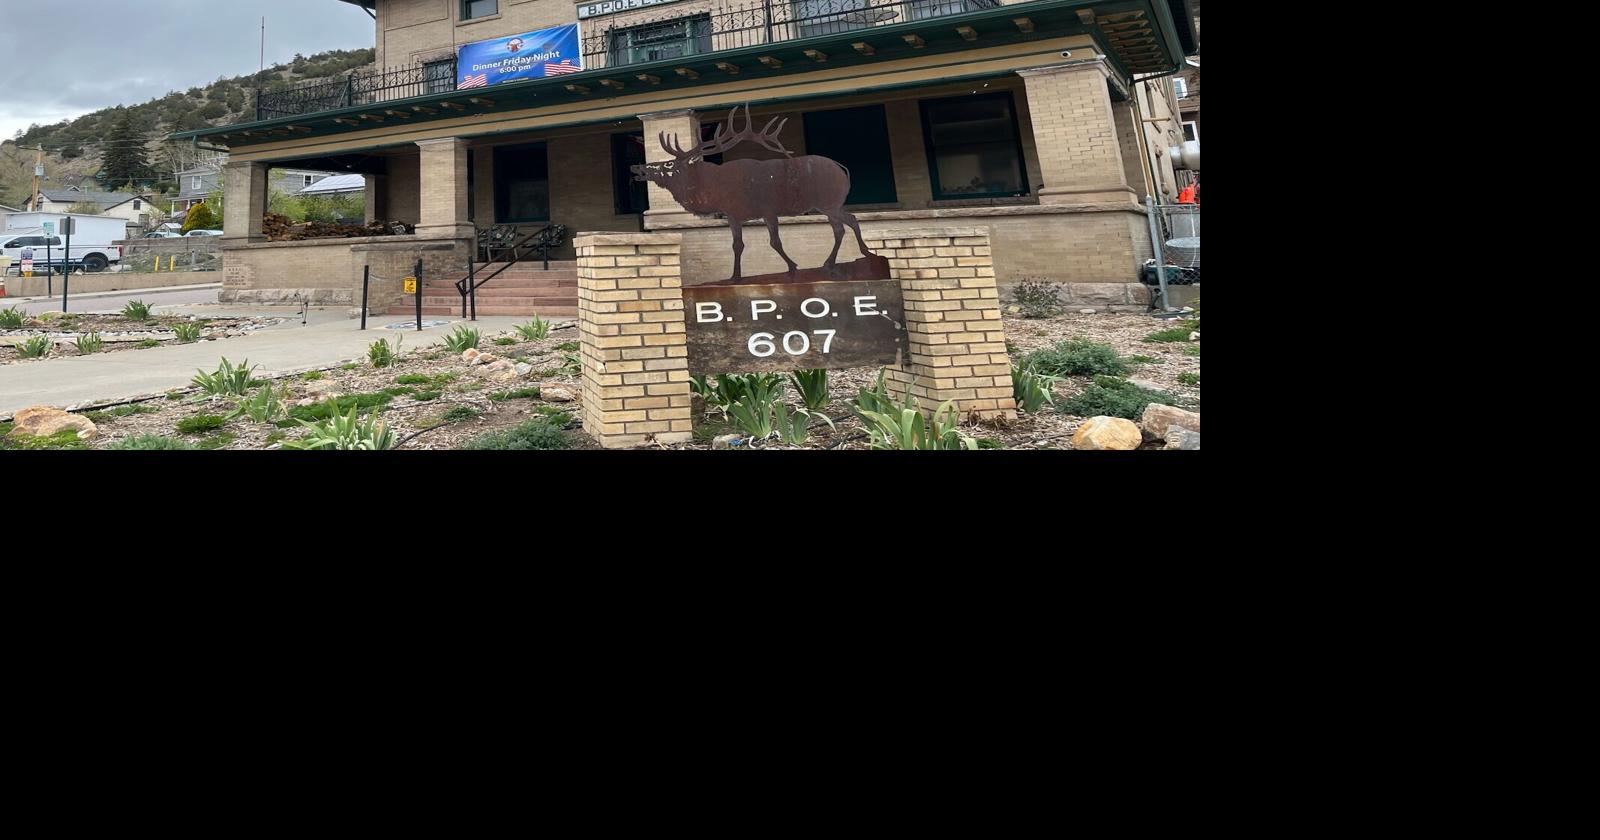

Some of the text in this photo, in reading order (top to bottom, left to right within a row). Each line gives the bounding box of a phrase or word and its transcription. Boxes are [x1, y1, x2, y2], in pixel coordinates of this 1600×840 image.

[472, 50, 560, 71] Dinner Friday Night
[500, 63, 531, 74] 6:00 pm
[747, 328, 836, 358] 607
